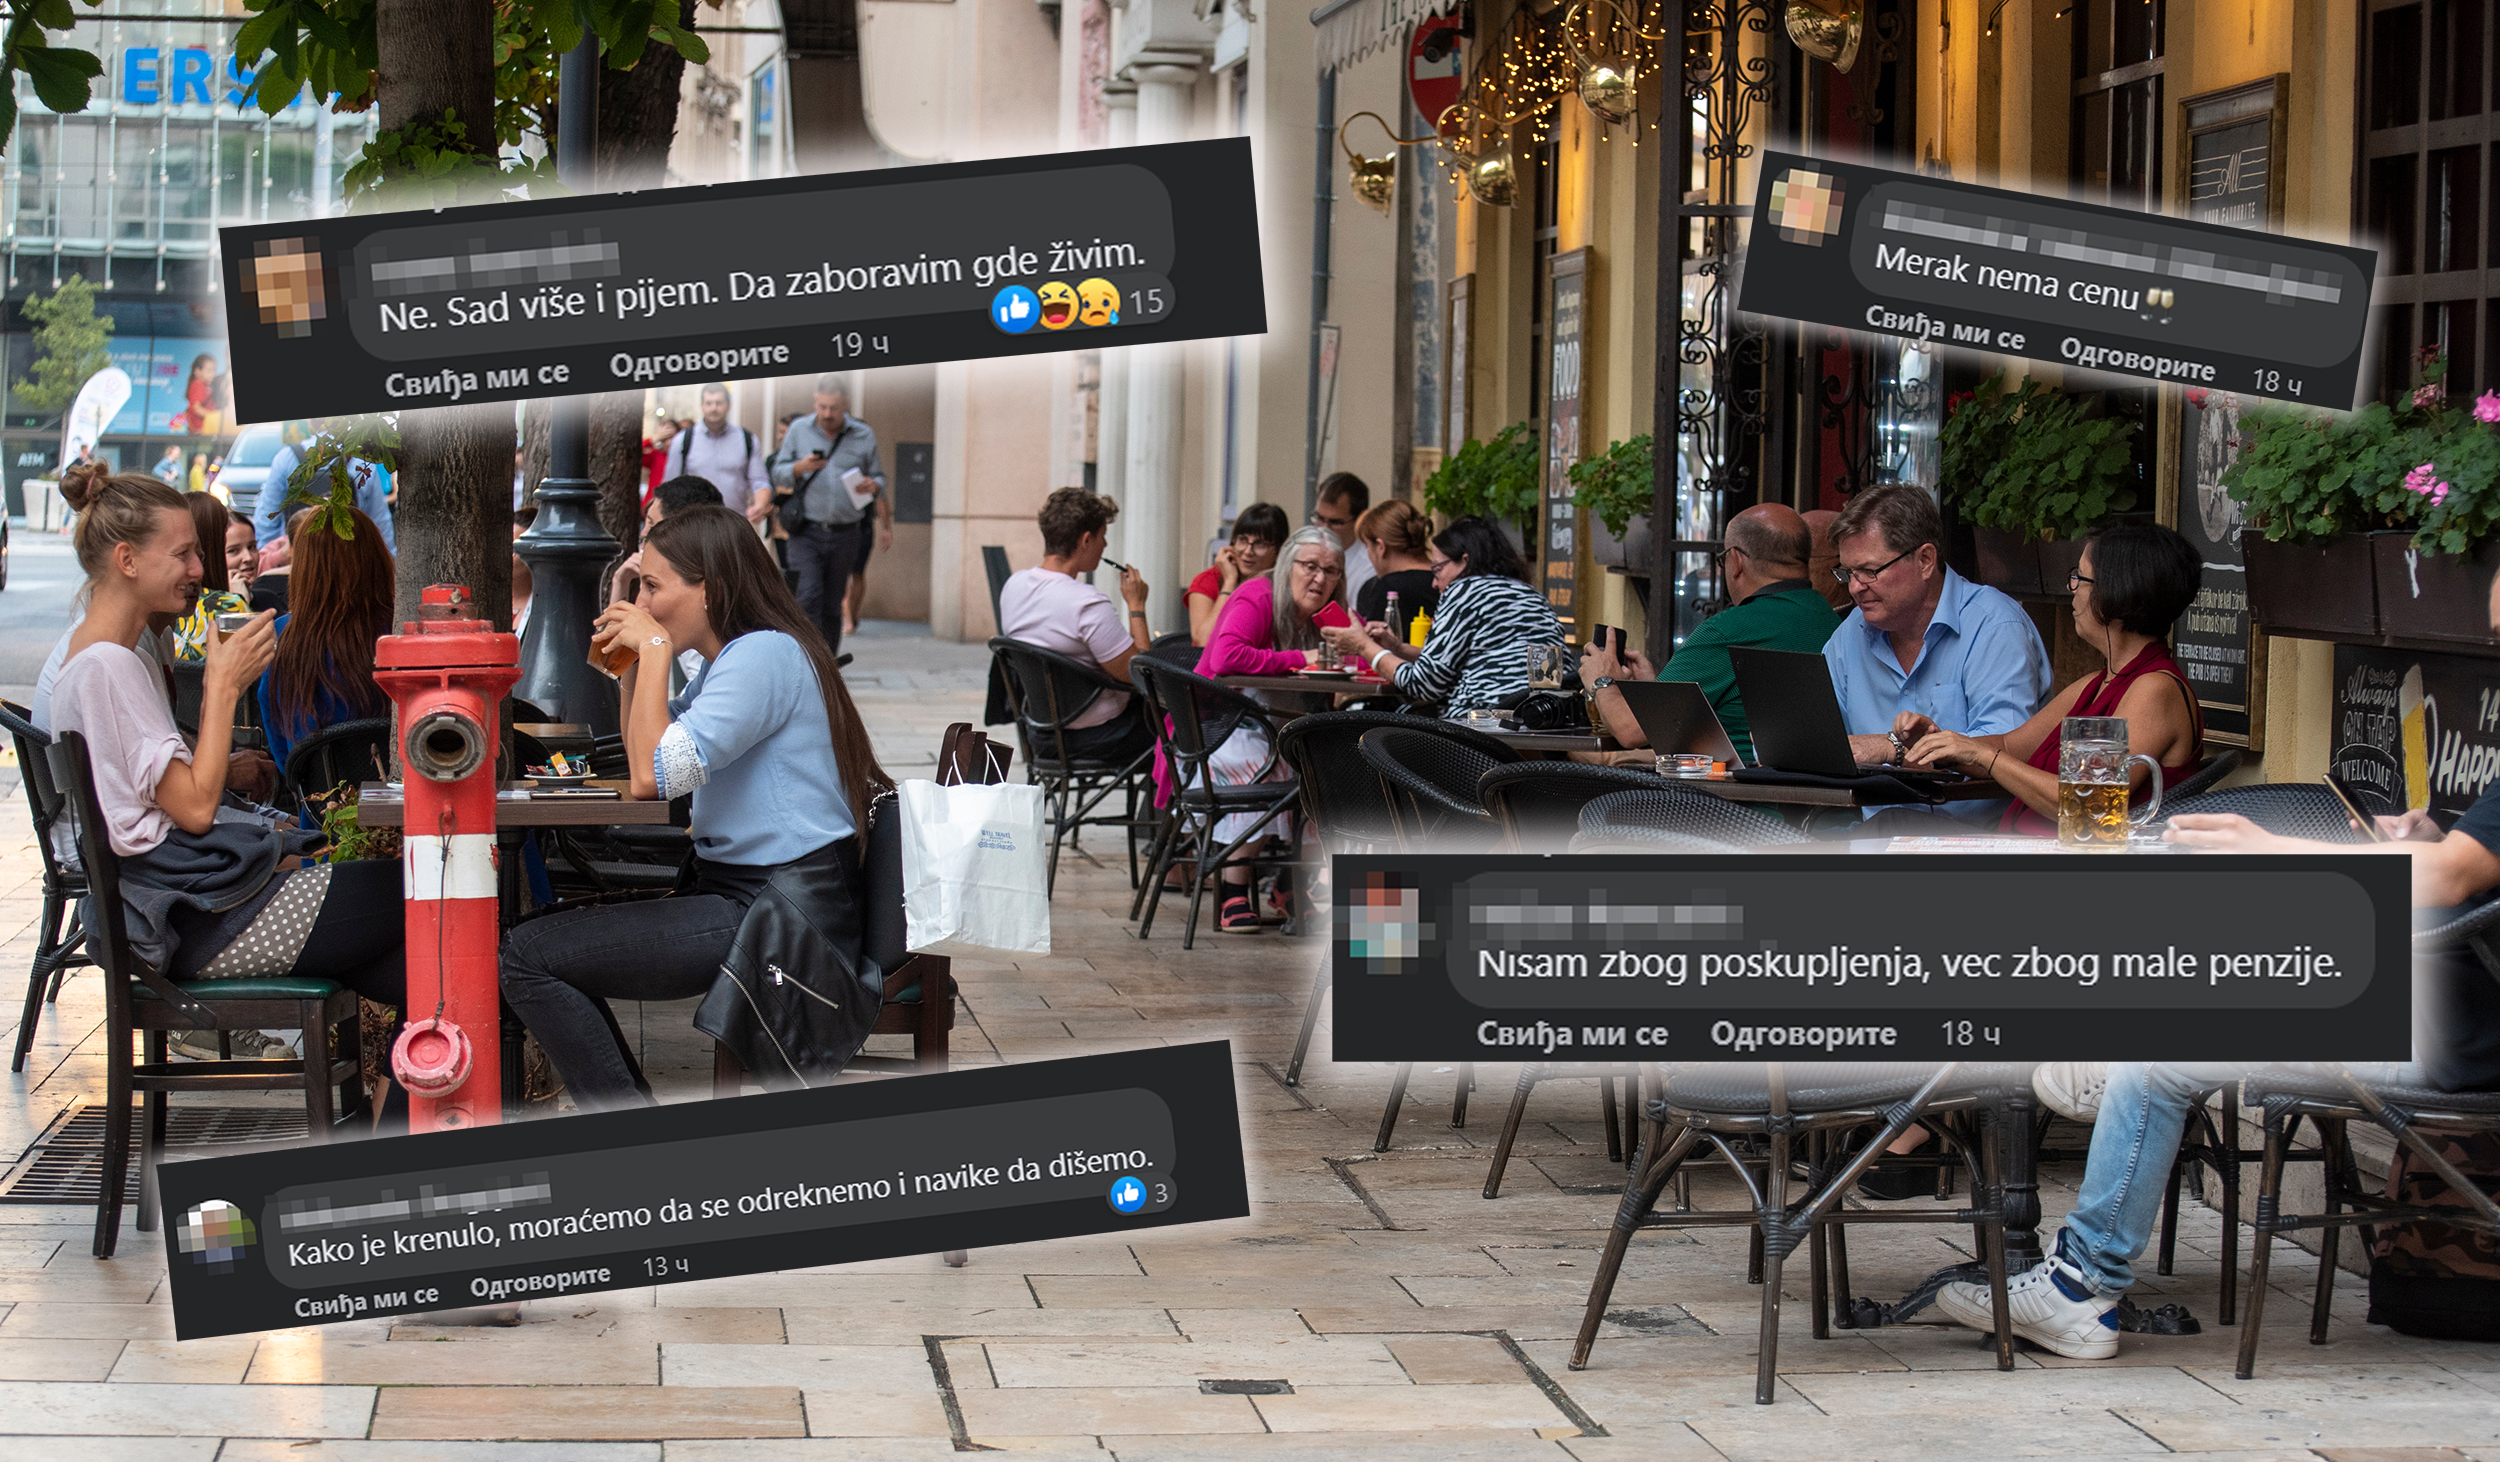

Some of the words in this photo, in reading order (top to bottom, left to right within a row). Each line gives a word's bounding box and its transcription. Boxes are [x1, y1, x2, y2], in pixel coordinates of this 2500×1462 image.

[2221, 201, 2256, 224] FAVOURITE
[17, 452, 45, 467] ATM
[2340, 665, 2399, 727] Always
[2343, 711, 2364, 746] ON
[2366, 713, 2397, 753] TAP
[2341, 759, 2391, 792] WELCOME
